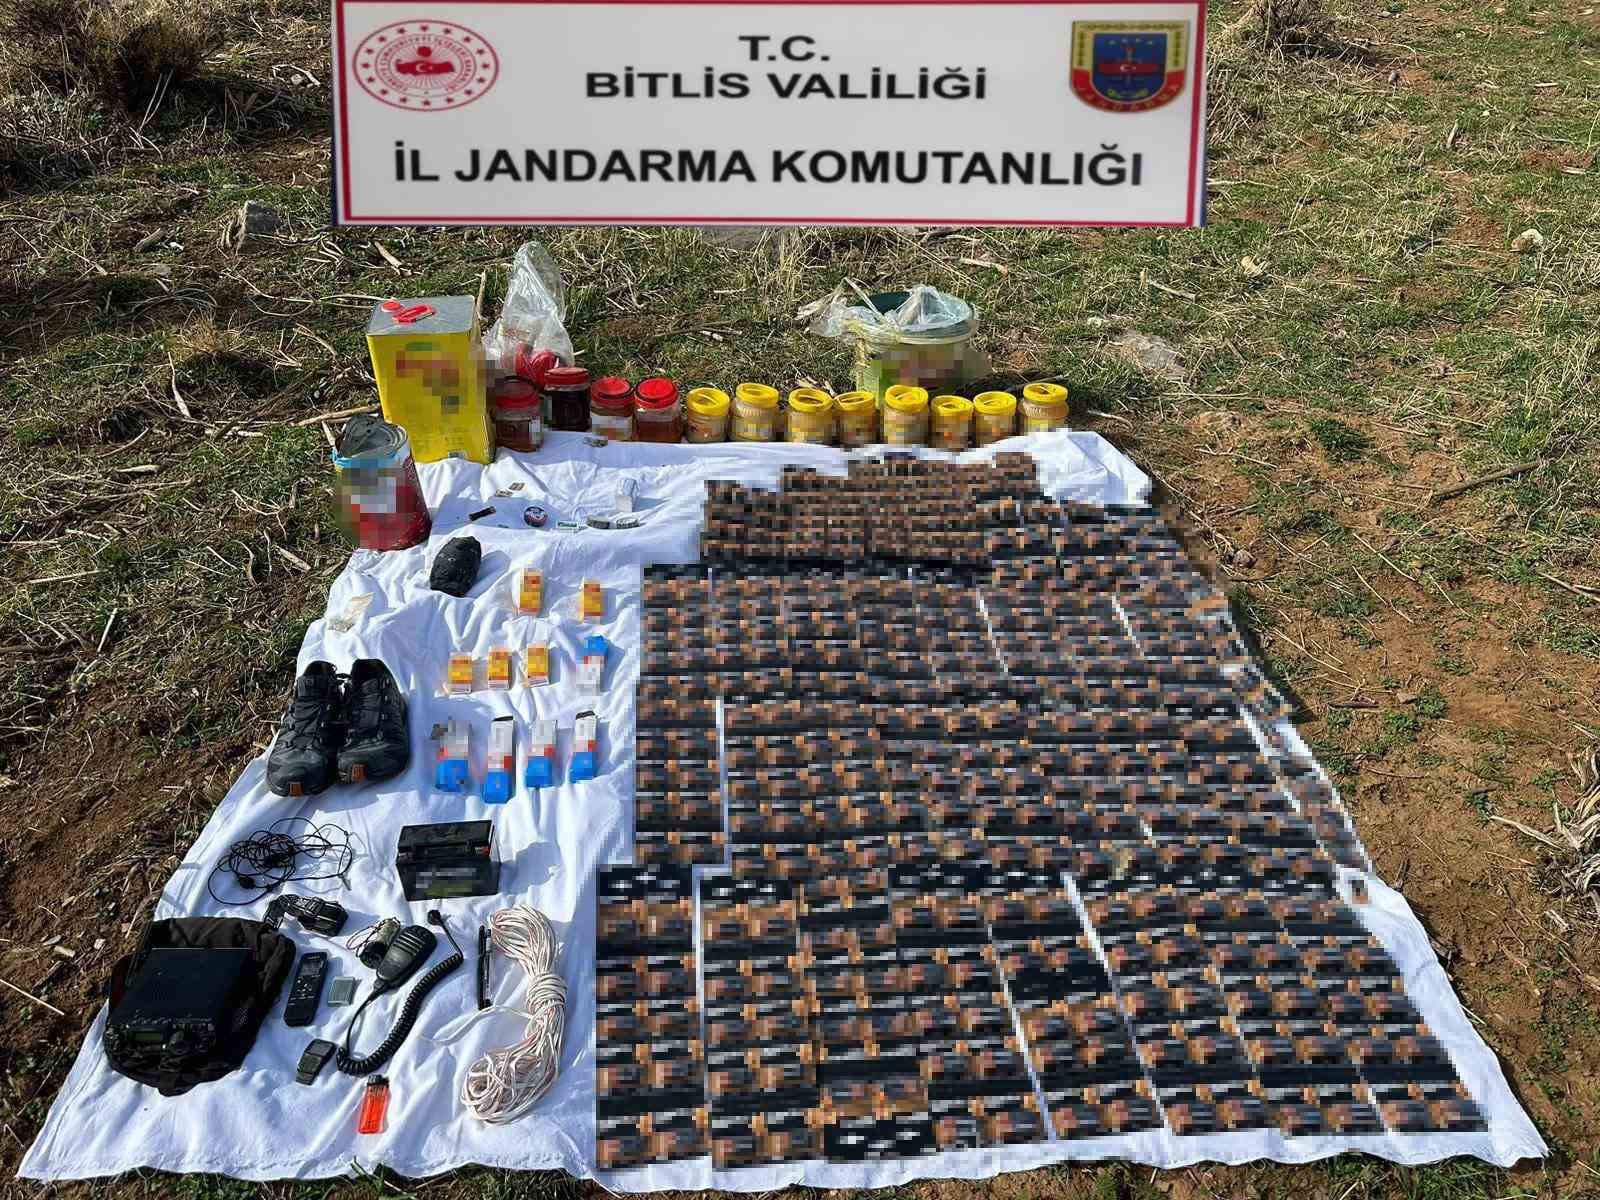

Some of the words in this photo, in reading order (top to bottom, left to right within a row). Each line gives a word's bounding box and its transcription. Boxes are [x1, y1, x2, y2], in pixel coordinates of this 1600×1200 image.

[738, 35, 830, 62] T.C.
[586, 66, 750, 99] BİTLİS
[767, 67, 986, 100] VALİLİĞİ
[394, 141, 440, 182] İL
[454, 149, 757, 183] JANDARMA
[772, 143, 1142, 186] KOMUTANLIĞI
